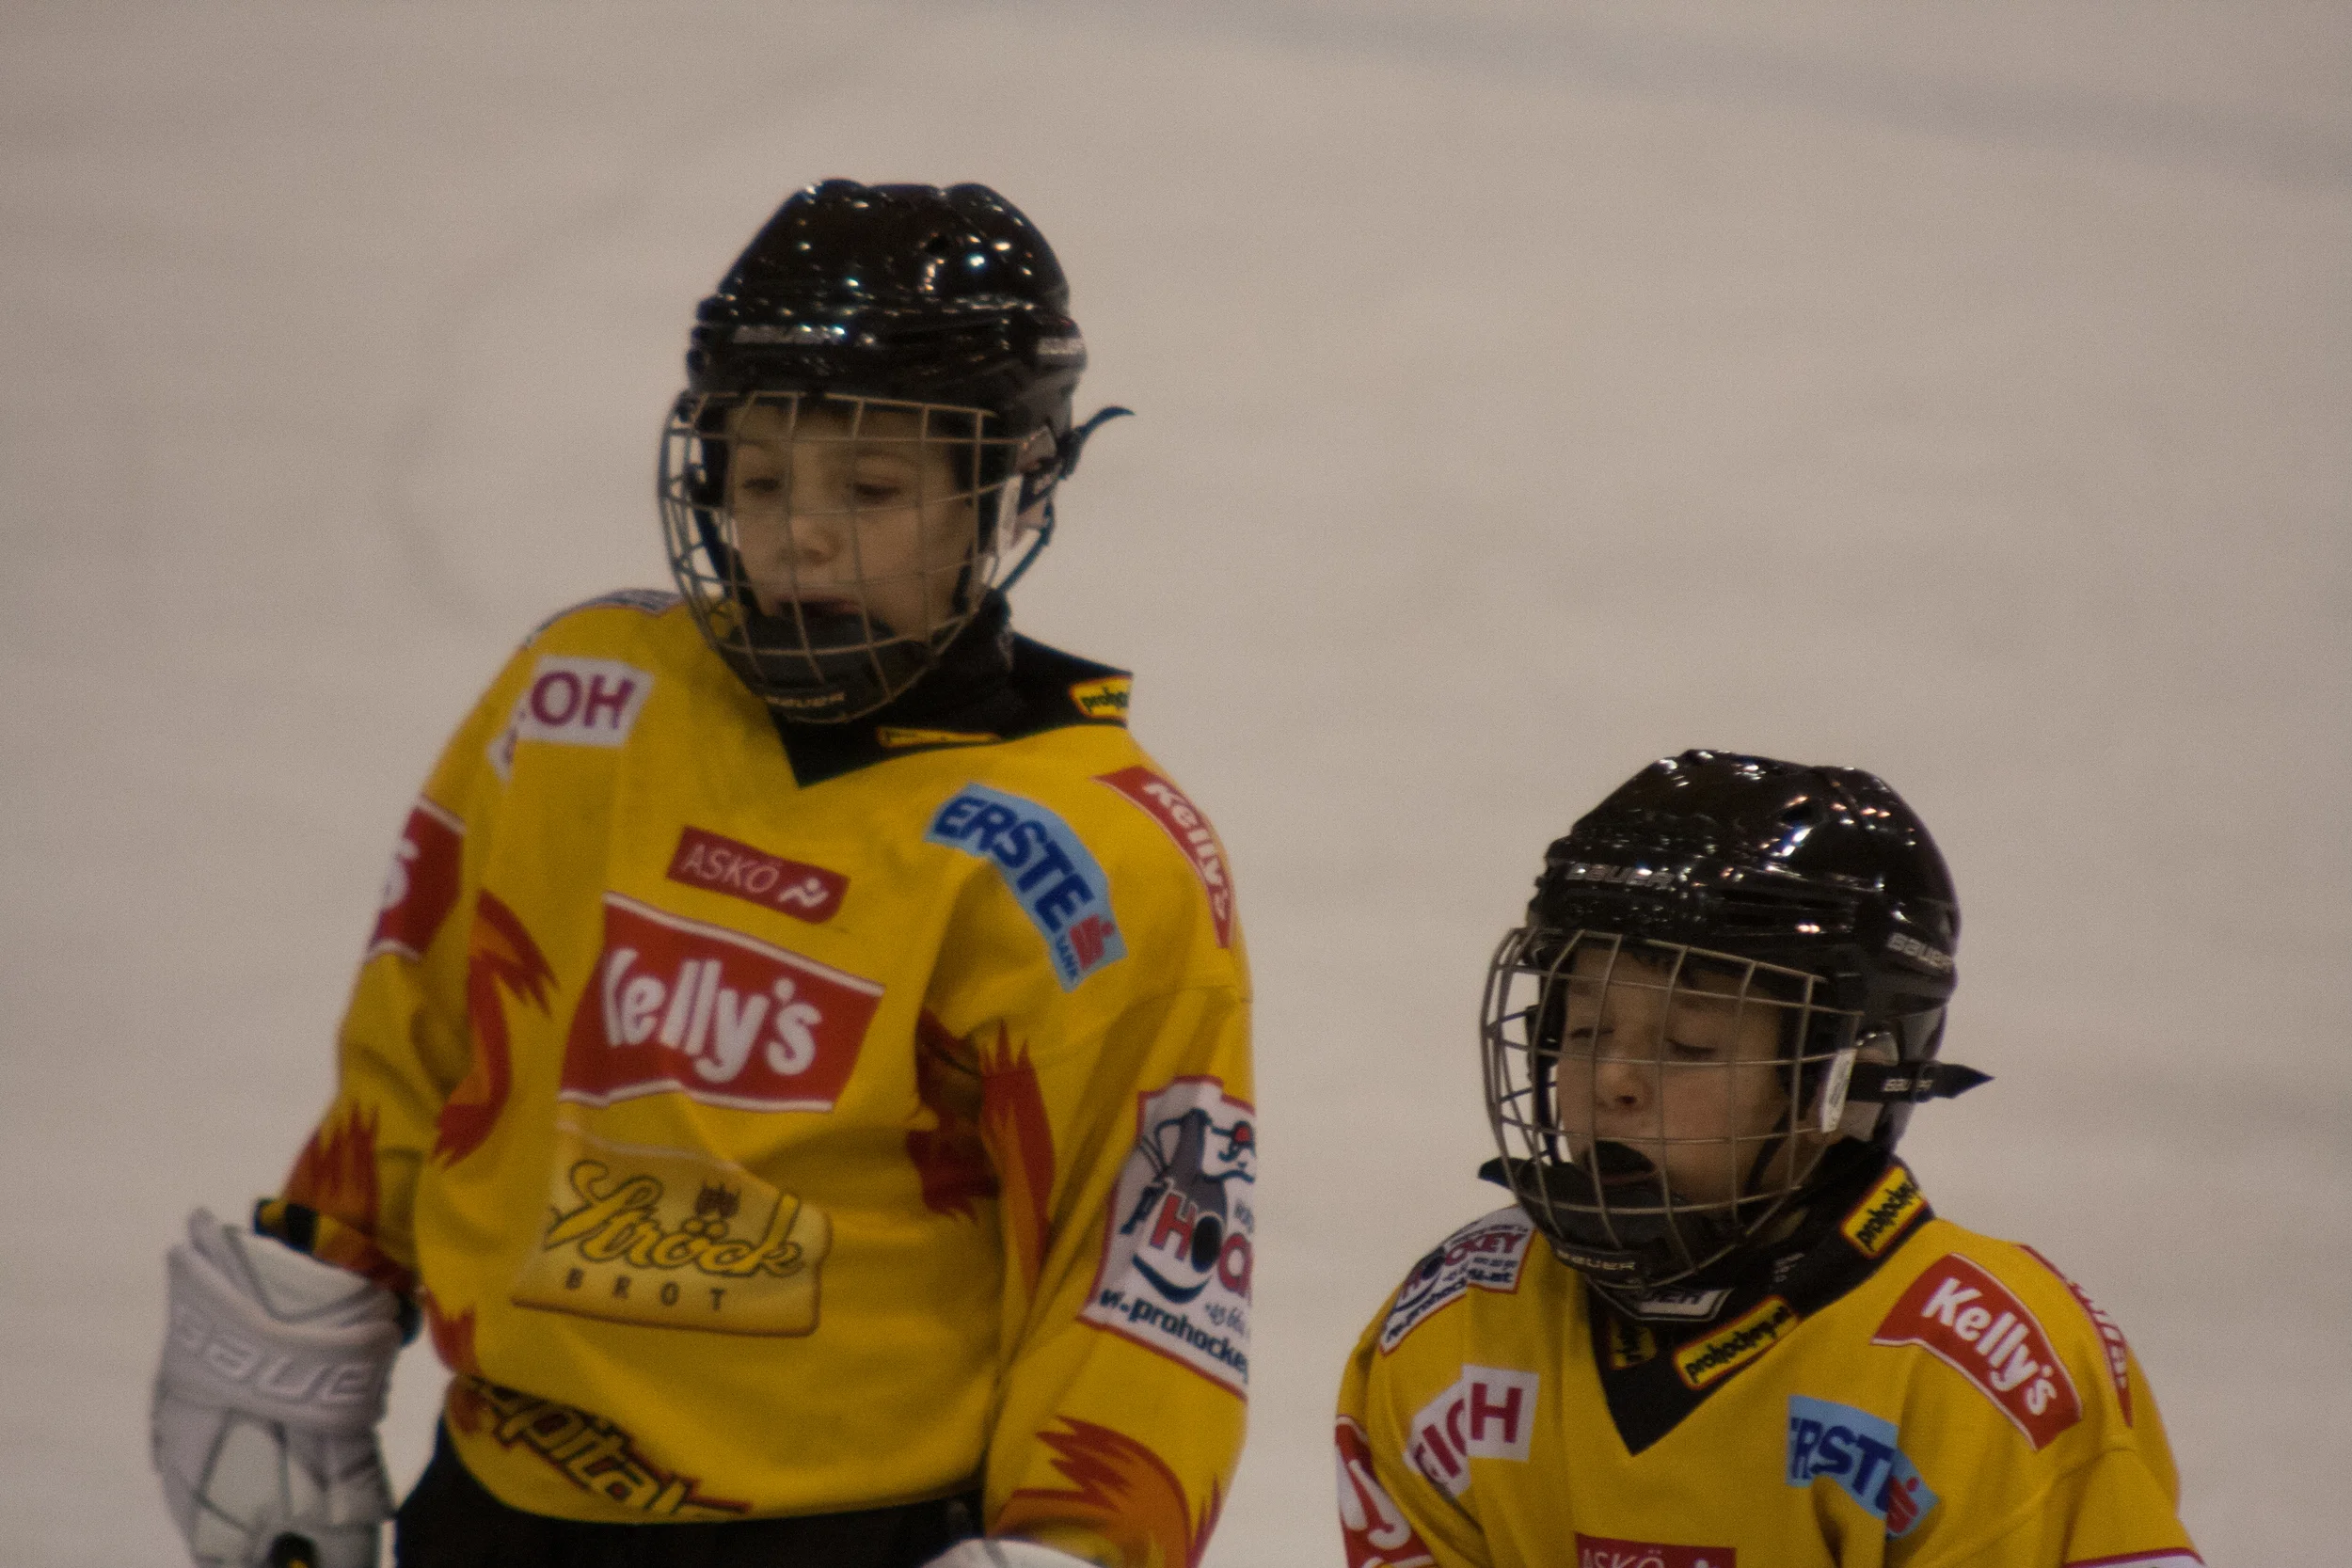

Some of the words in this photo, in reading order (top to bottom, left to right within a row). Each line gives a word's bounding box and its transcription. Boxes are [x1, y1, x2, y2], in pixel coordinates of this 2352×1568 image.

[933, 795, 1097, 934] ERSTE
[564, 1267, 726, 1311] BROT
[1922, 1276, 2058, 1417] Kelly's
